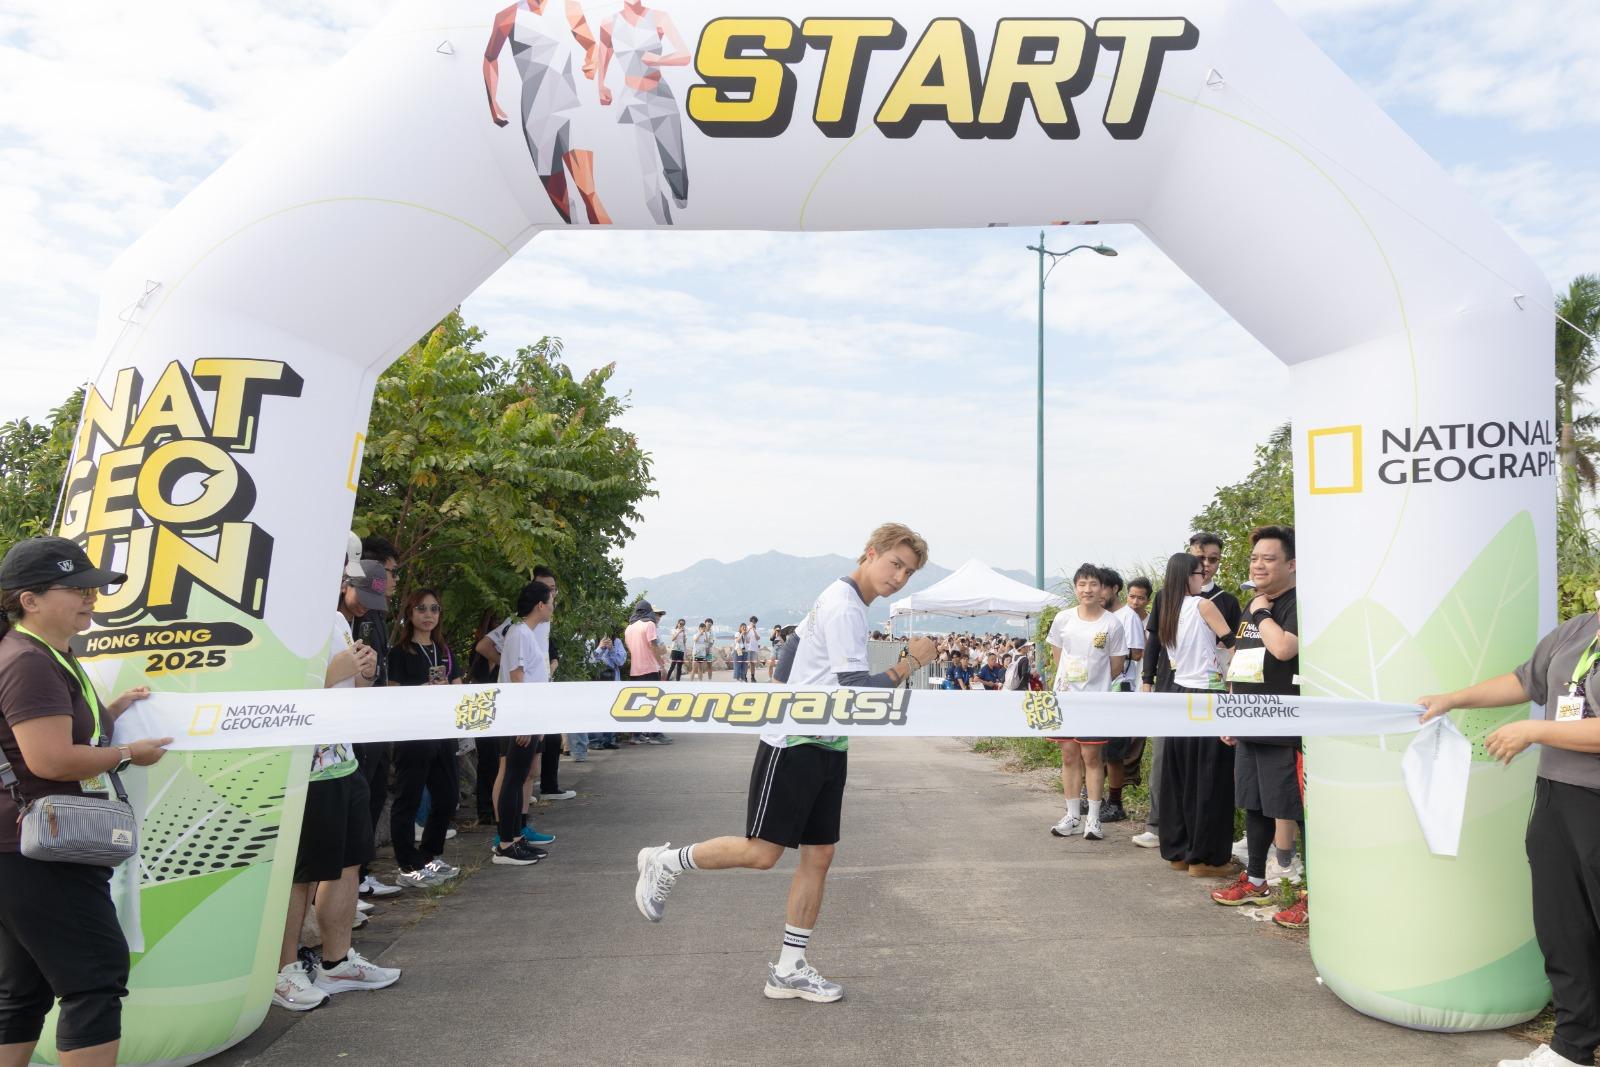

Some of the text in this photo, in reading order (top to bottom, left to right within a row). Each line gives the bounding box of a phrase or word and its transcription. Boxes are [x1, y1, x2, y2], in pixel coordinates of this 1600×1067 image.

[685, 16, 1200, 140] START
[77, 357, 304, 463] NAT
[1381, 420, 1553, 454] NATIONAL
[59, 440, 257, 539] GEO
[85, 521, 274, 627] UN
[86, 629, 212, 652] HONG KONG
[145, 650, 226, 672] 2025
[462, 688, 501, 704] NAT
[610, 686, 912, 727] Congrats!
[1023, 694, 1058, 713] GEO
[226, 704, 297, 717] NATIONAL
[455, 707, 497, 729] RUN
[1026, 707, 1063, 729] RUN
[1216, 706, 1300, 718] GEOGRAPHIC
[221, 714, 315, 730] GEOGRAPHIC
